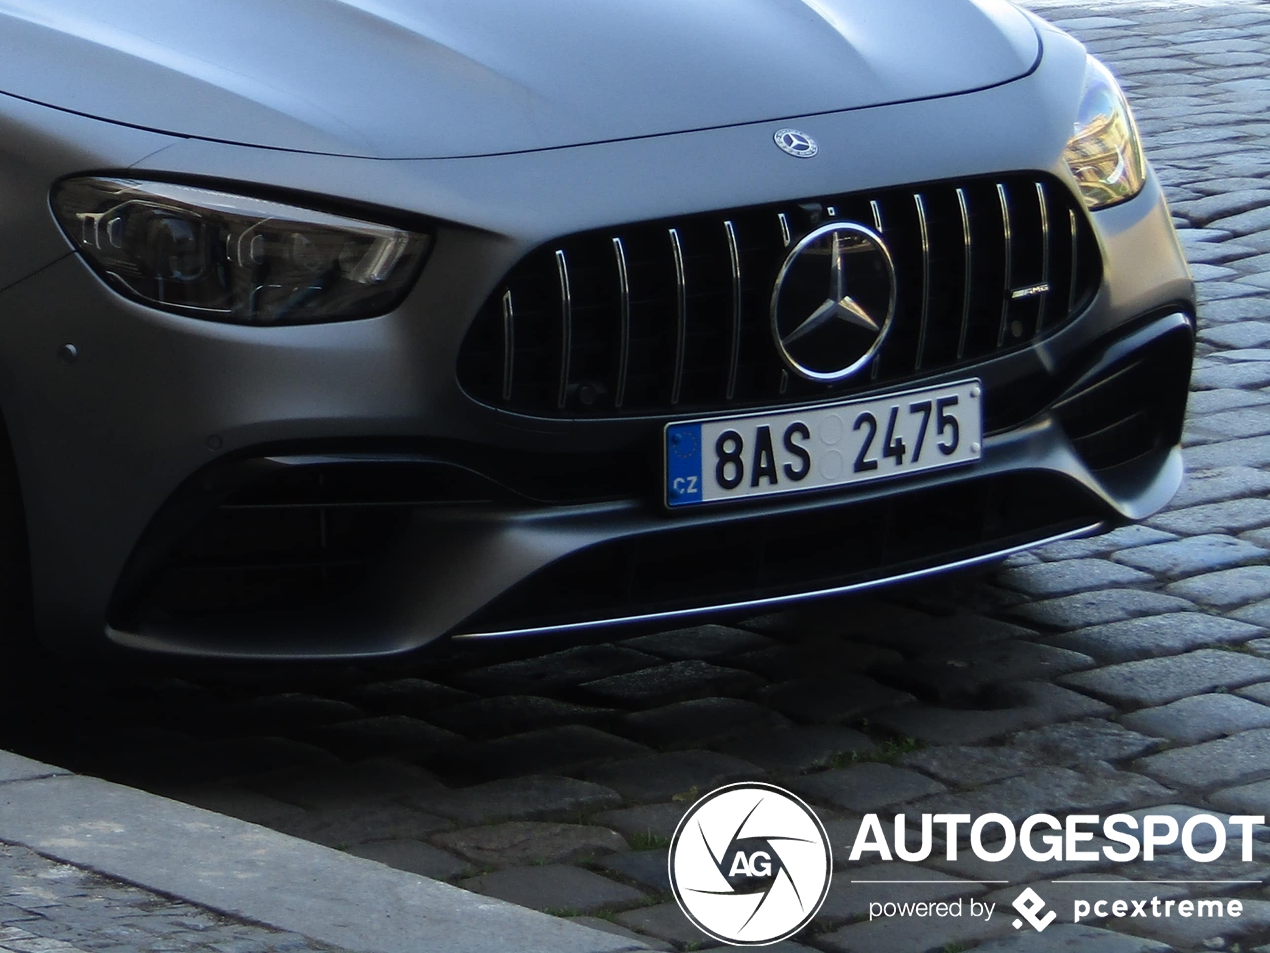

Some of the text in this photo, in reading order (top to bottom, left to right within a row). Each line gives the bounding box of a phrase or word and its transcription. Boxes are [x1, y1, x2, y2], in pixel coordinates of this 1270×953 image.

[715, 394, 960, 490] 8AS 2475
[673, 475, 698, 494] CZ
